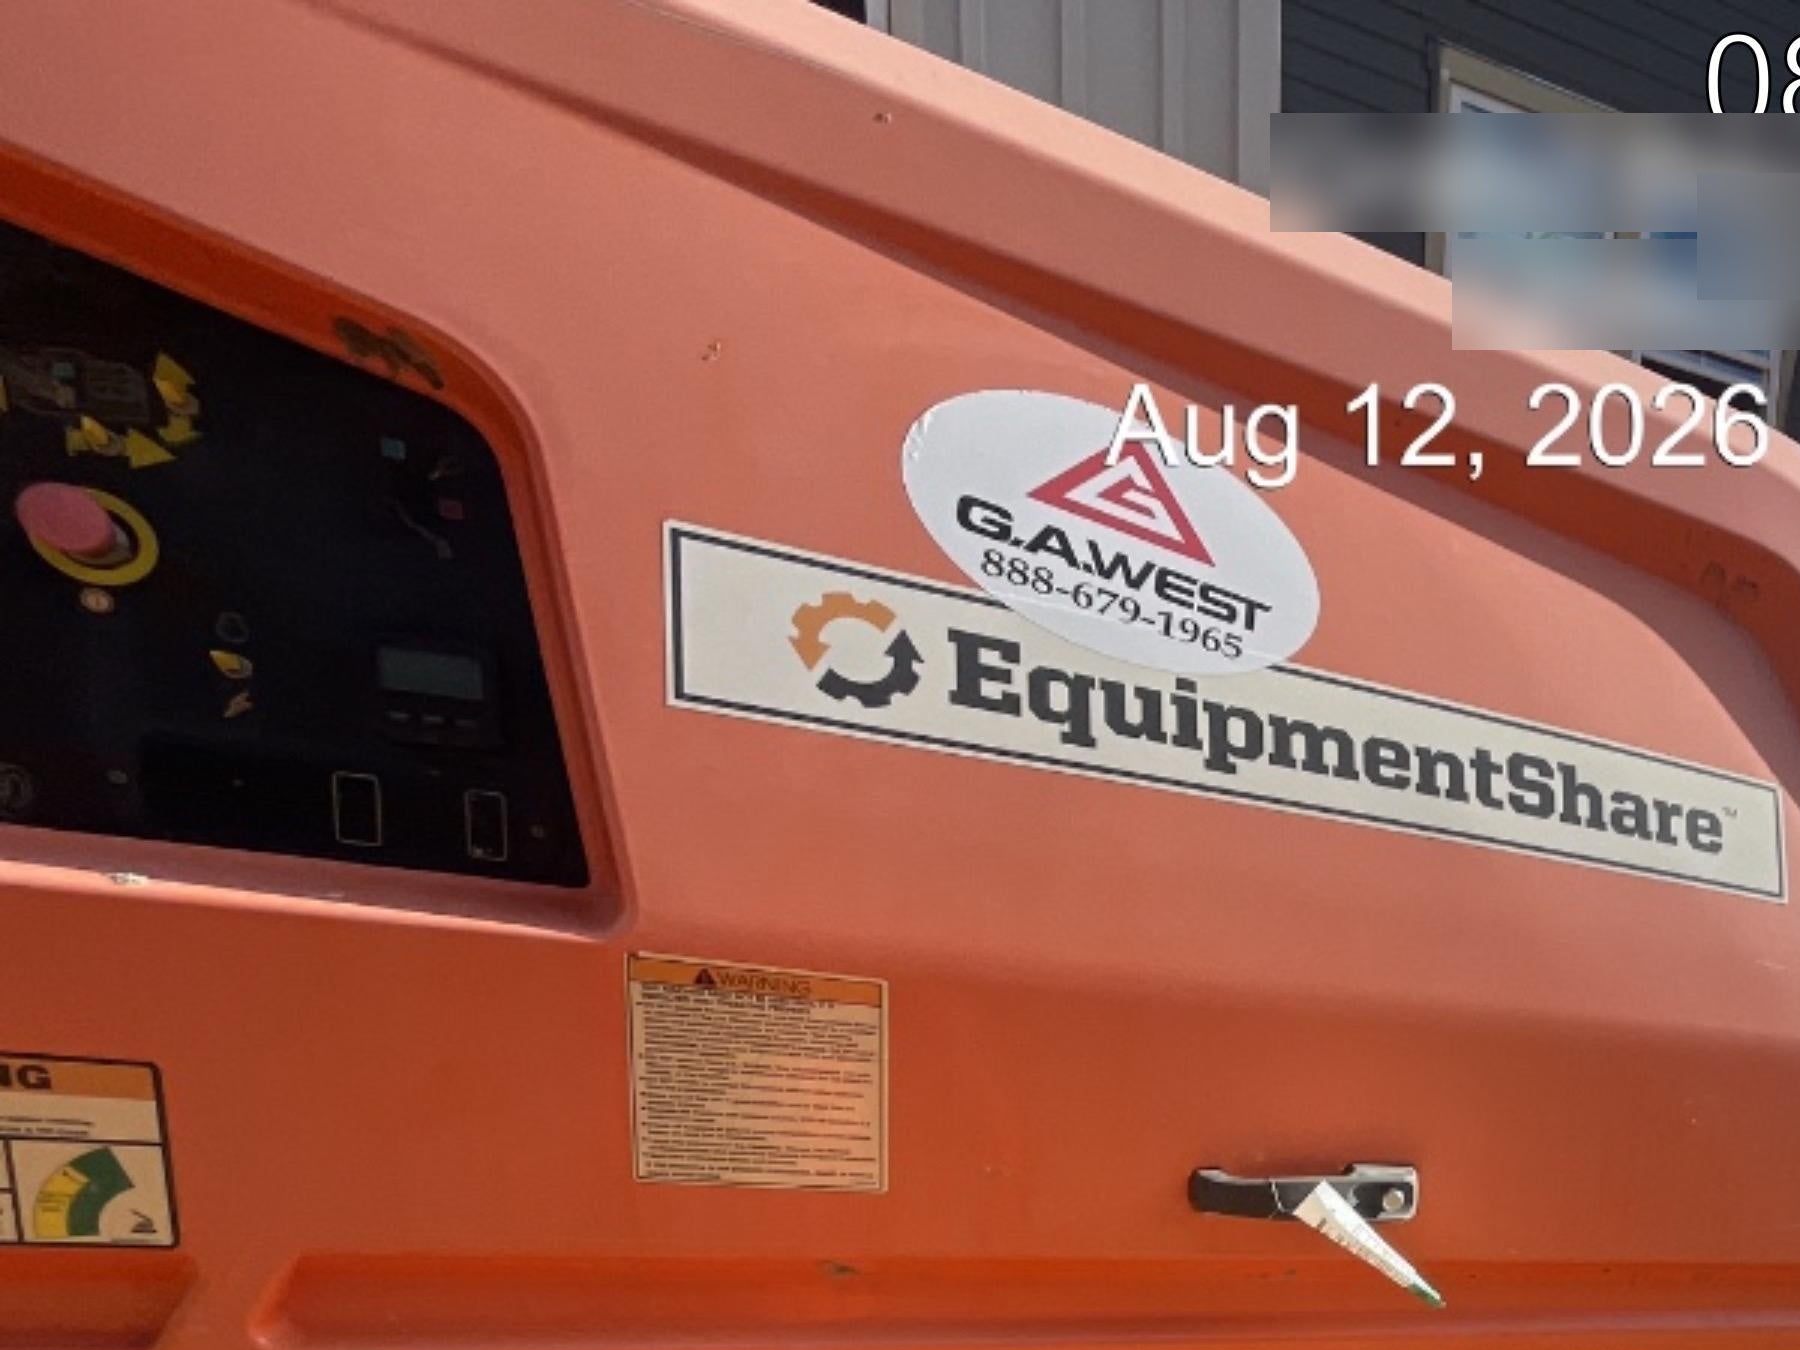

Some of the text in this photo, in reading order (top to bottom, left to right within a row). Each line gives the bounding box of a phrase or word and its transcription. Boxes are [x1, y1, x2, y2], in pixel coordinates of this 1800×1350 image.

[981, 549, 1242, 659] 888-679-1965
[947, 628, 1722, 855] EquipmentShare
[716, 971, 812, 996] WARNING
